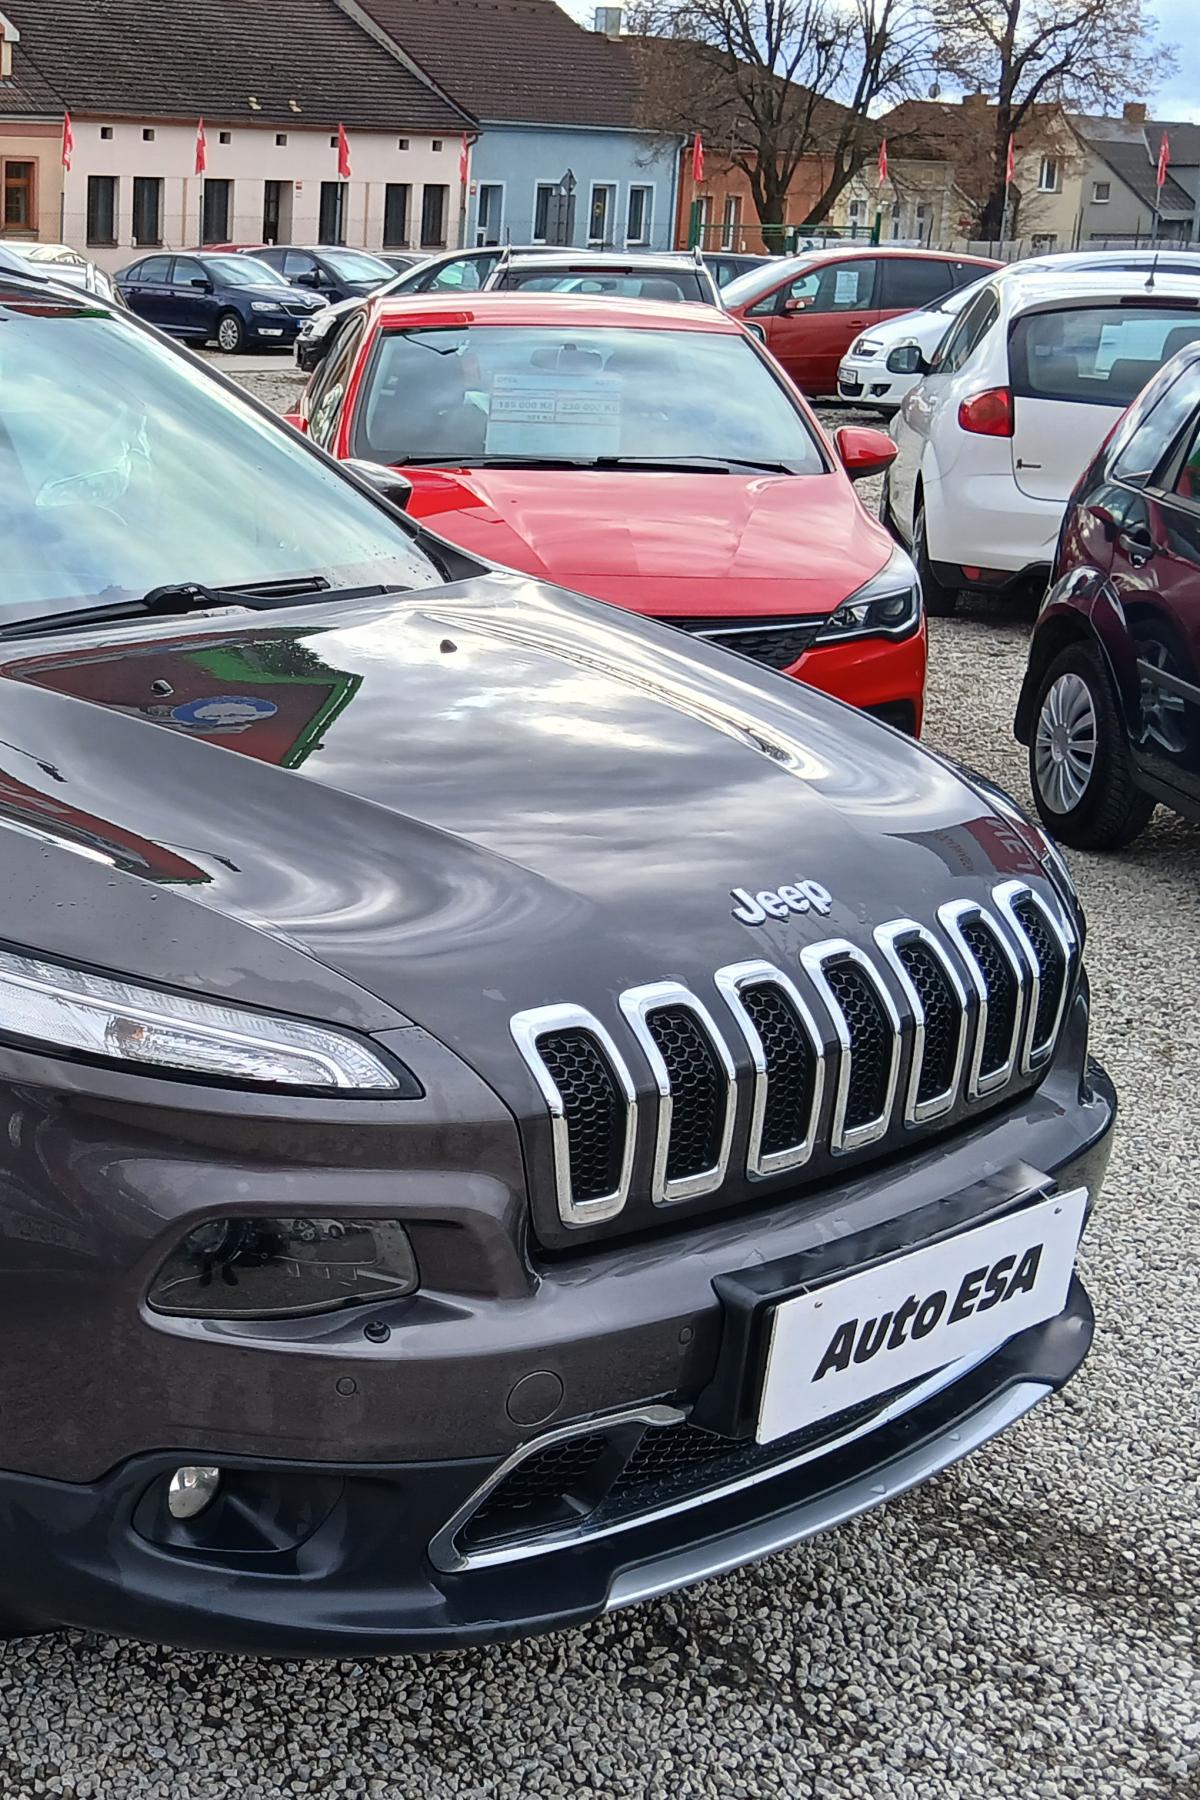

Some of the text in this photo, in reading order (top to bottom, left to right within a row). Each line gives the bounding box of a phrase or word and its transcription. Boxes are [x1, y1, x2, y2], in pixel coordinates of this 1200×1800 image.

[730, 880, 833, 926] Jeep
[811, 1243, 1044, 1384] Auto ESA
